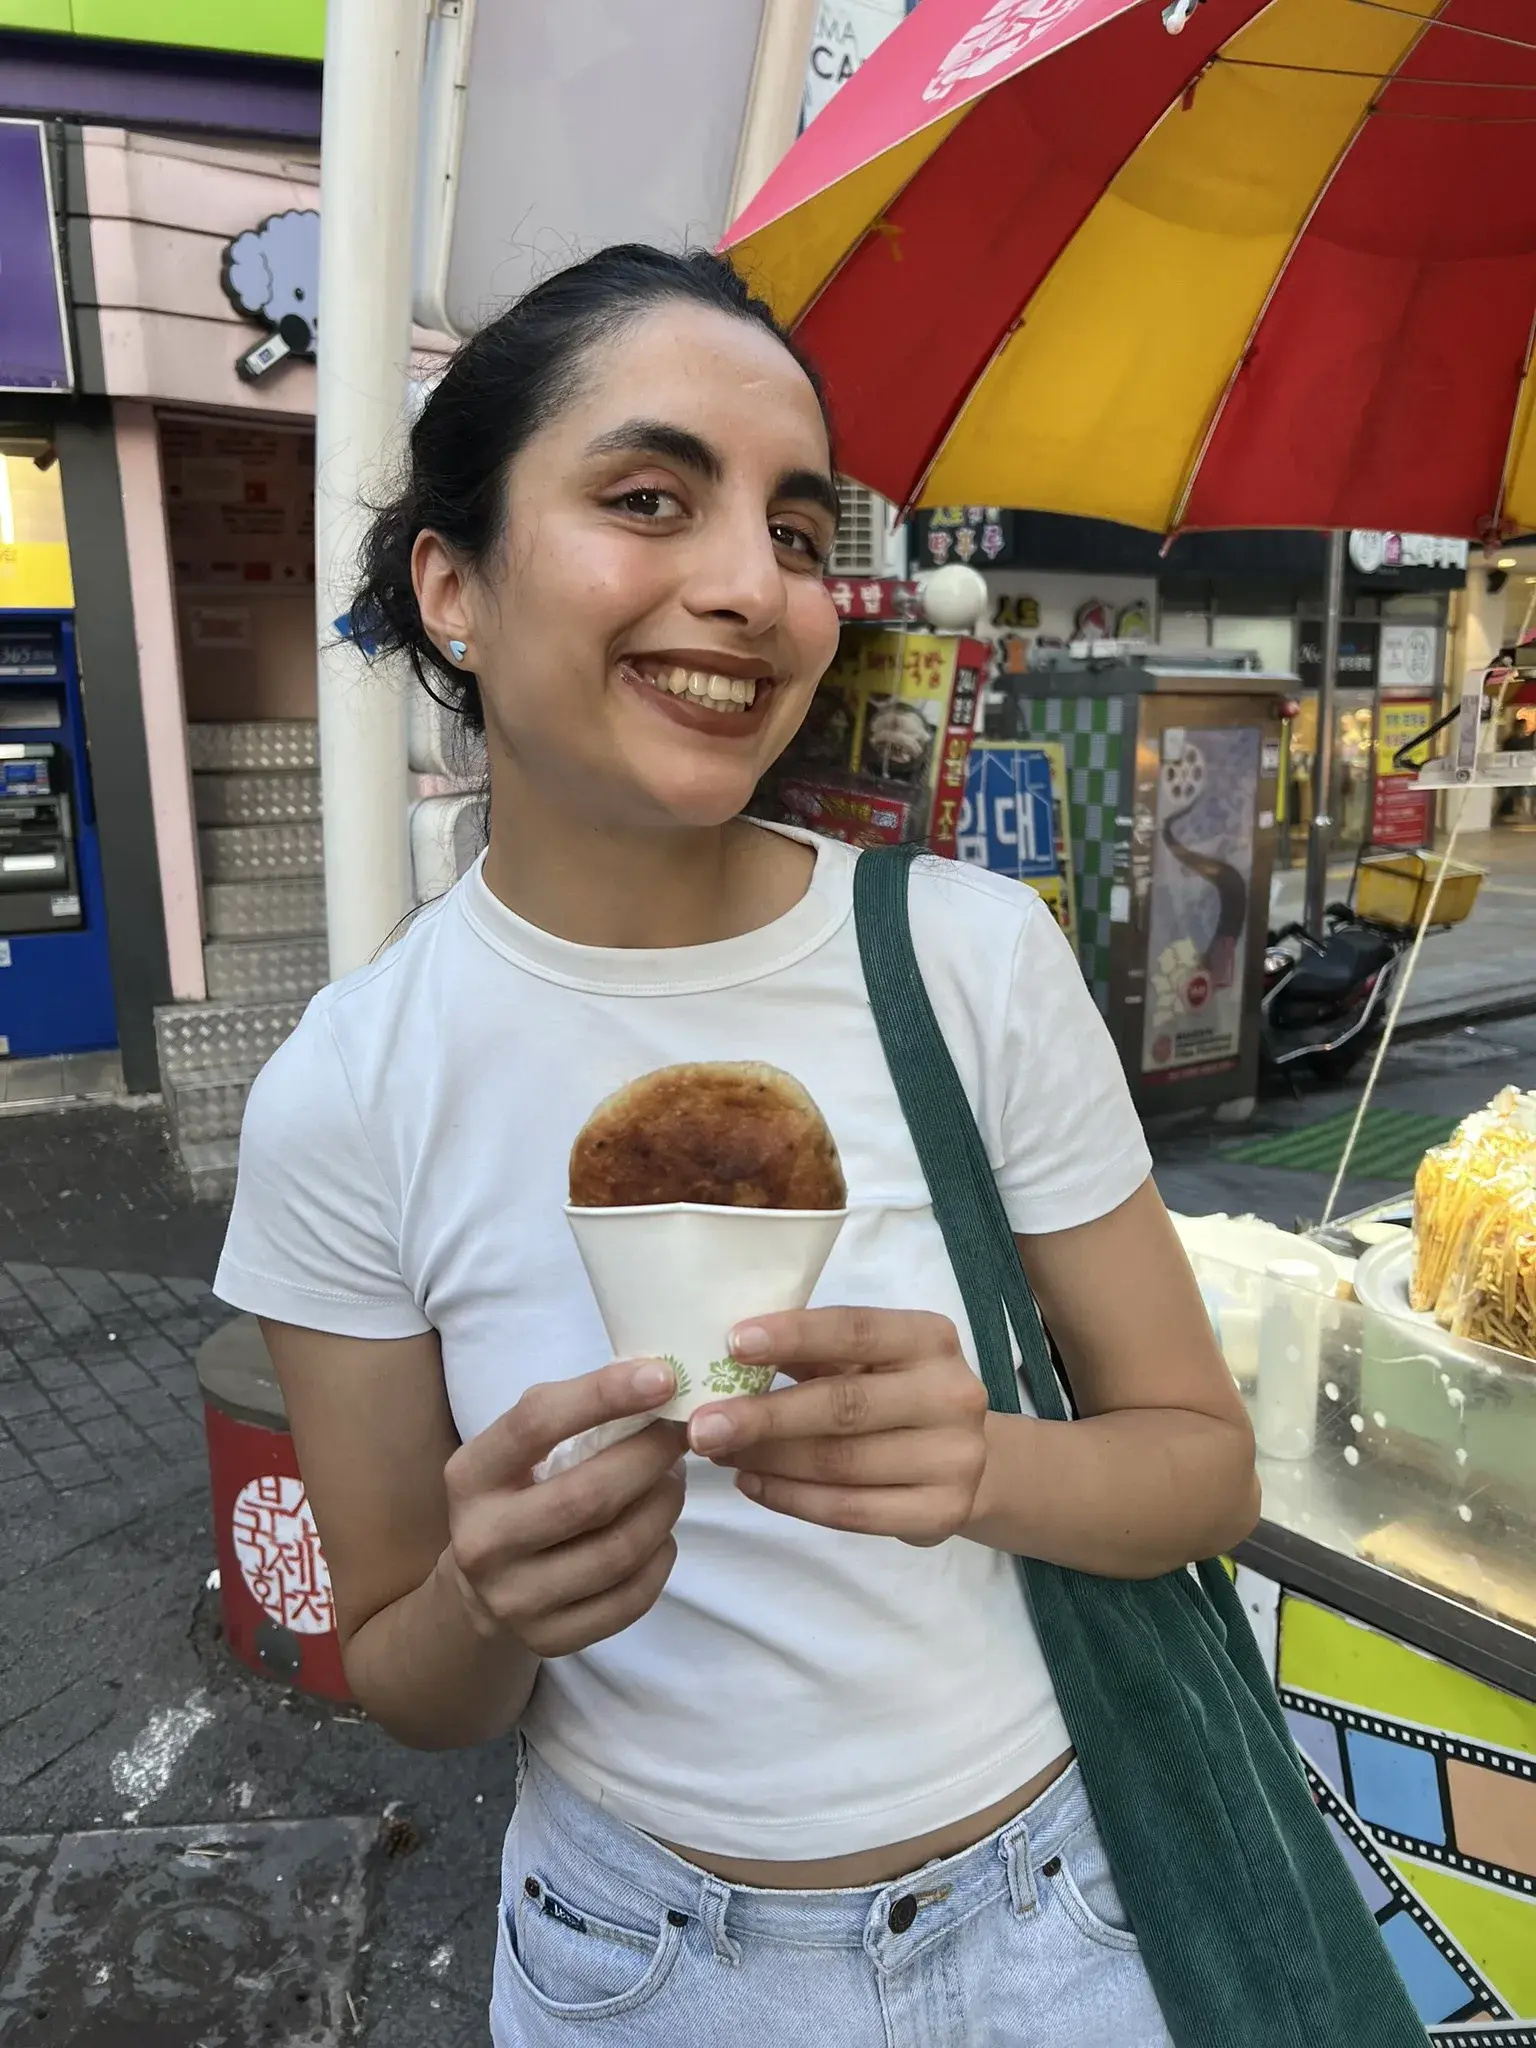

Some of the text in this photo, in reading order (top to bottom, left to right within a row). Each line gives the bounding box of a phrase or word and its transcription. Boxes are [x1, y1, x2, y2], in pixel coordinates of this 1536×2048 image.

[811, 46, 866, 83] CA
[832, 582, 884, 614] 국밥
[955, 790, 1037, 868] 임대
